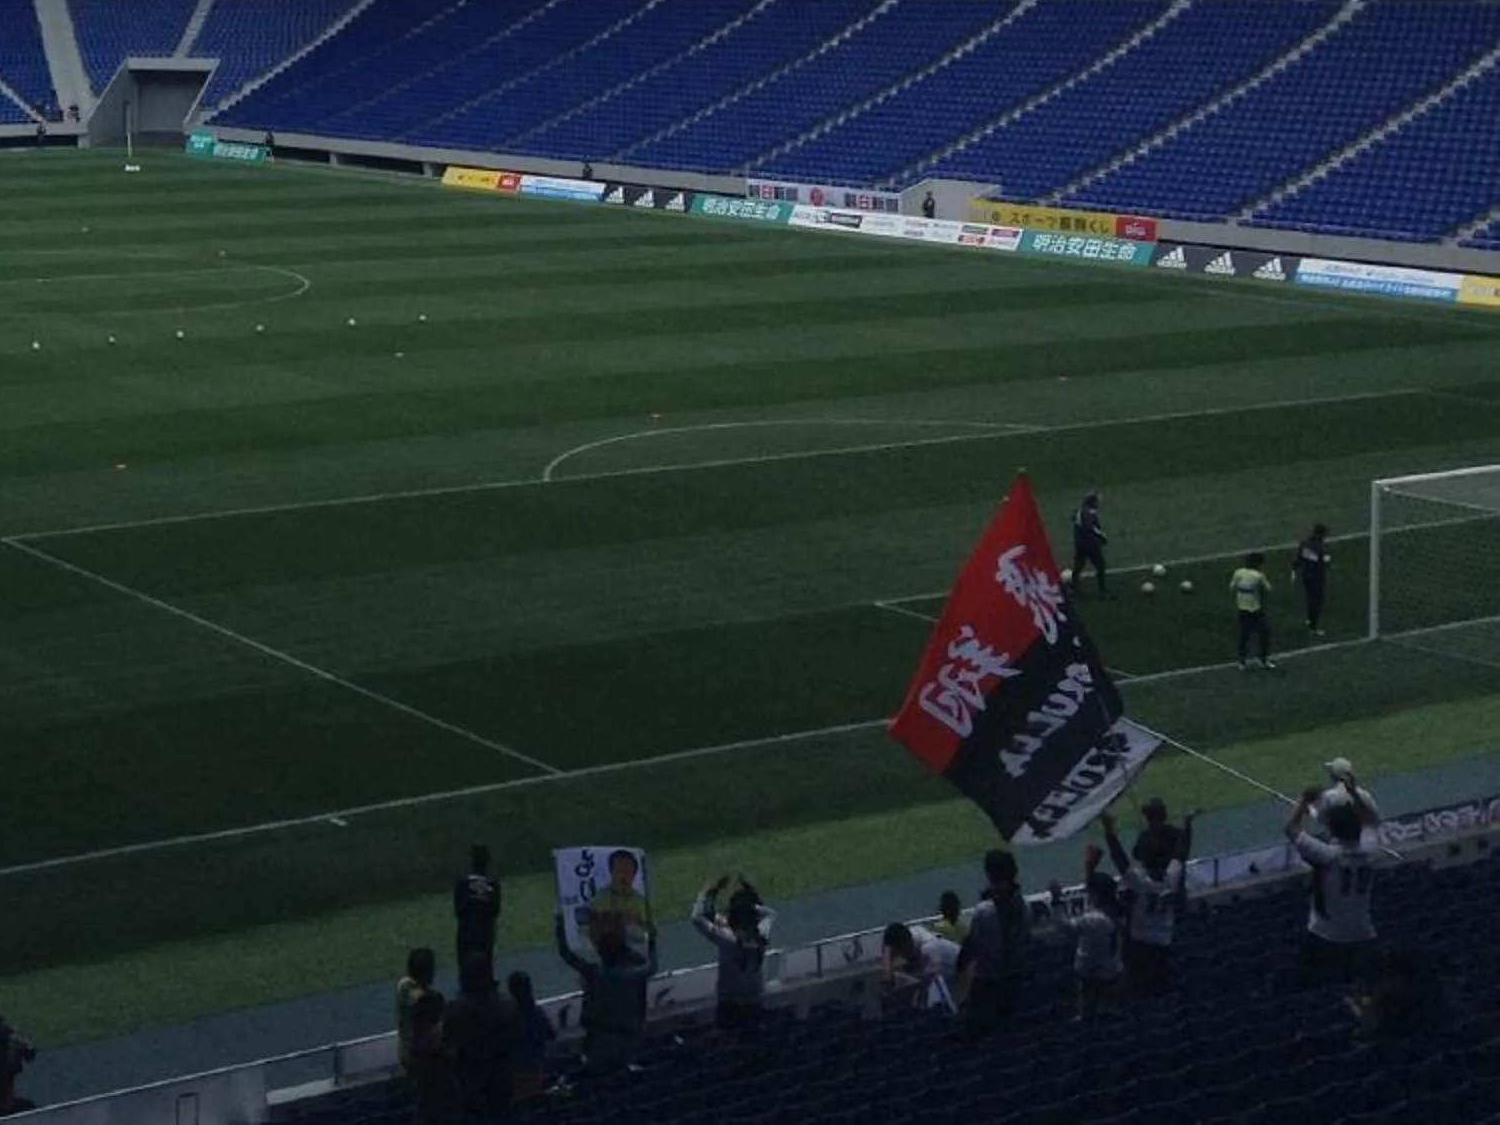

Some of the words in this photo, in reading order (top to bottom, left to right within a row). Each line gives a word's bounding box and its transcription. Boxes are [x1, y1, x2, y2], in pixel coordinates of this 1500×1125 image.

[1031, 233, 1137, 261] 明治安田生命
